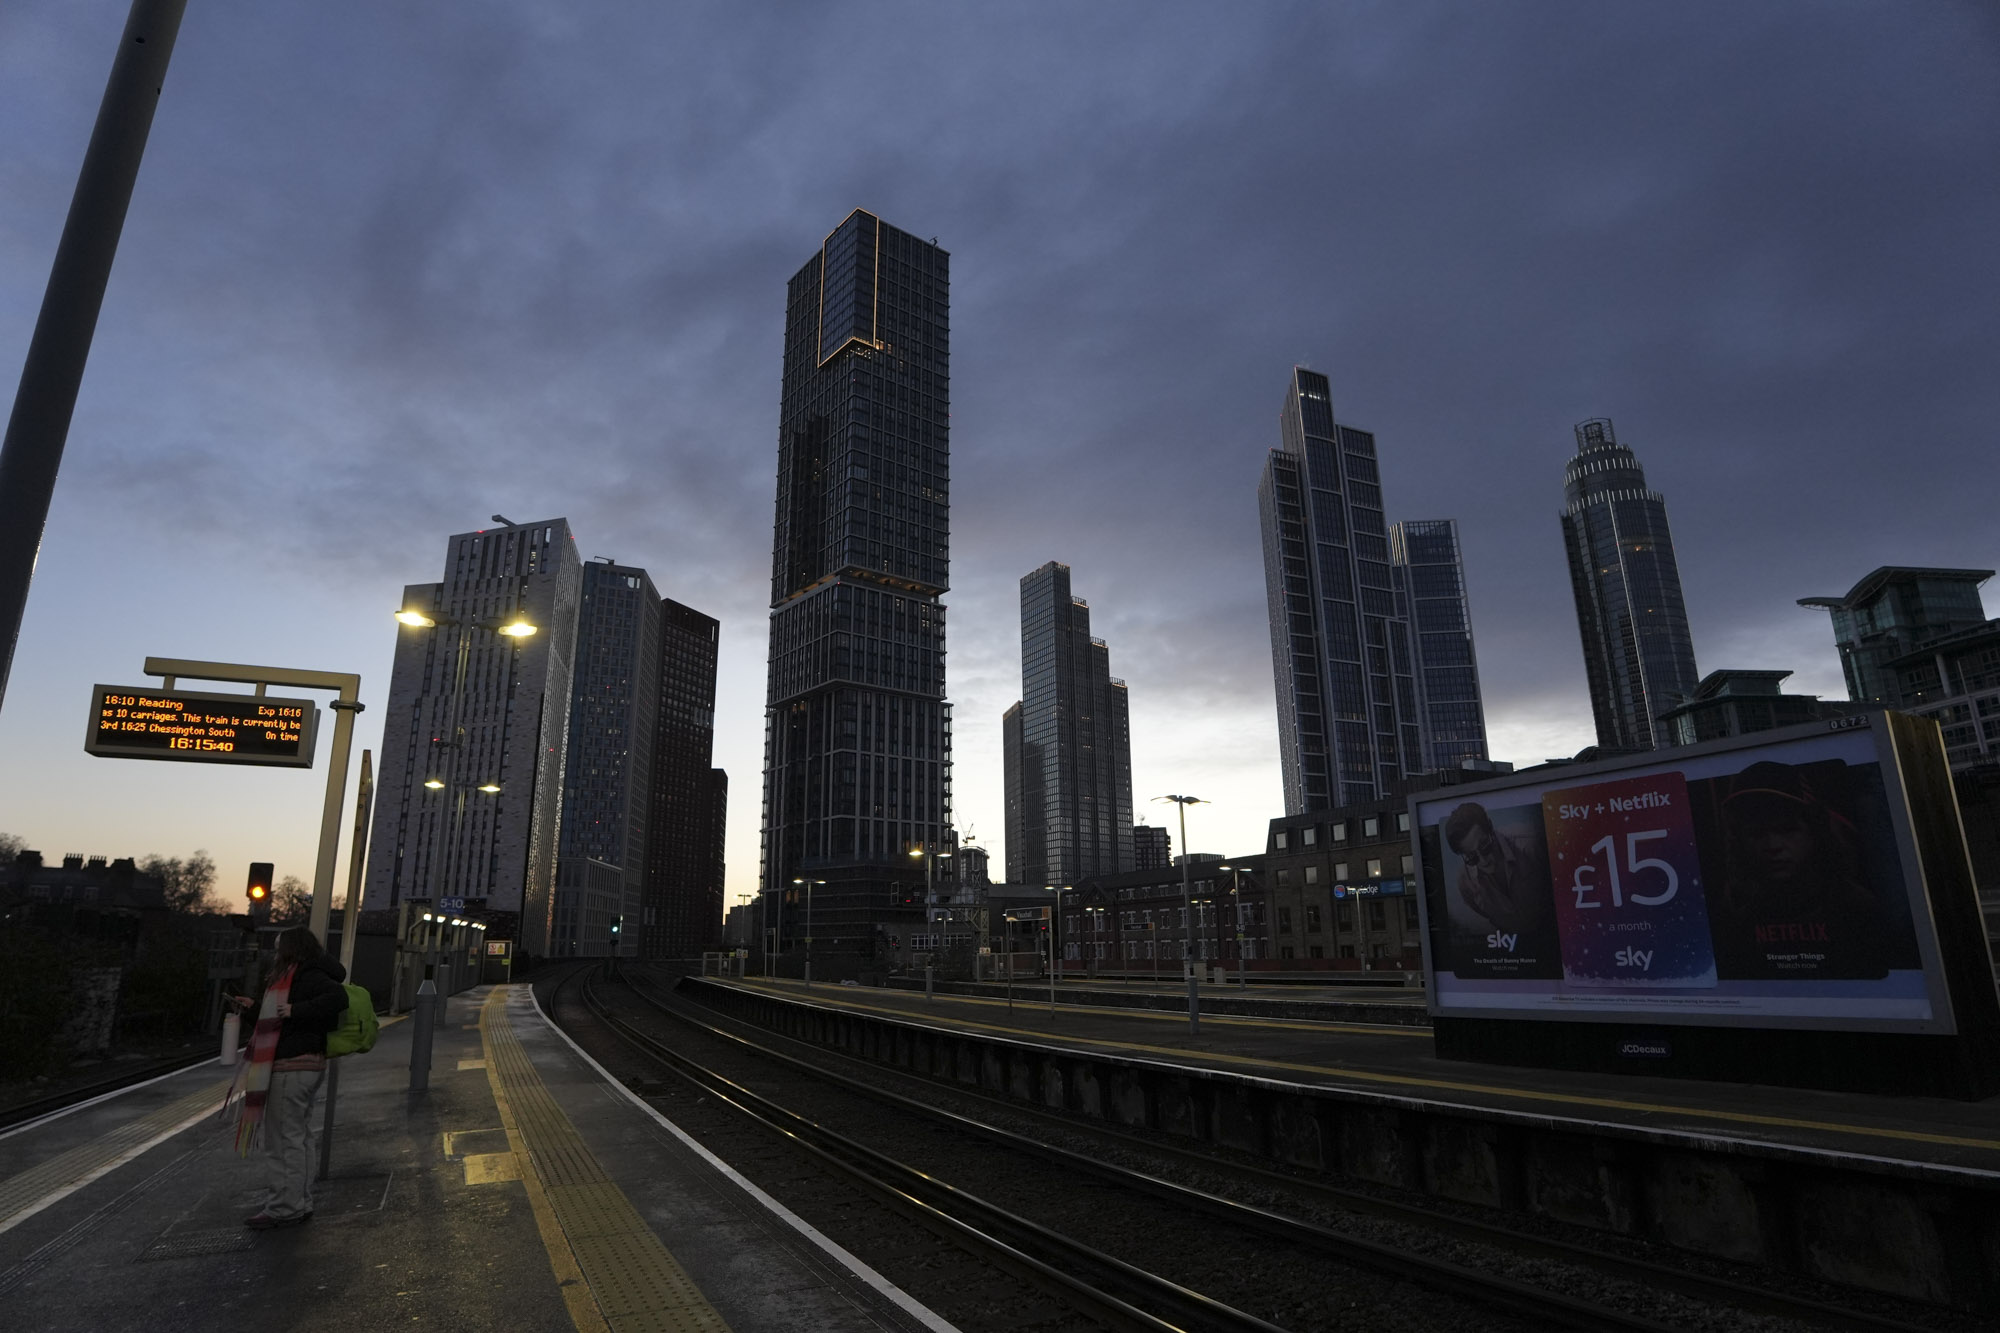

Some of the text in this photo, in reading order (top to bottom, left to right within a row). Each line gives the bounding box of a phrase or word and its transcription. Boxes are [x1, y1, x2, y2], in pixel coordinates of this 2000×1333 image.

[105, 695, 302, 717] 16:10 Reading Exp 16:16
[100, 720, 298, 741] 3rd 16:25 Chessington South On time
[116, 709, 128, 718] 10
[130, 711, 178, 722] carriages.
[182, 712, 202, 723] This
[205, 714, 228, 725] train
[231, 716, 240, 726] is
[243, 719, 287, 731] currently
[290, 720, 301, 730] be
[1830, 715, 1868, 729] 0672
[169, 737, 234, 752] 16:15:40
[1559, 804, 1590, 820] Sky
[1609, 791, 1672, 813] Netflix
[1572, 829, 1679, 909] £15
[1617, 920, 1652, 931] month
[1755, 921, 1829, 943] NETFLIX
[1487, 929, 1518, 952] sky
[1614, 945, 1654, 971] sky
[1766, 952, 1826, 961] Stranger Things
[1622, 1043, 1667, 1055] JCDecaux
